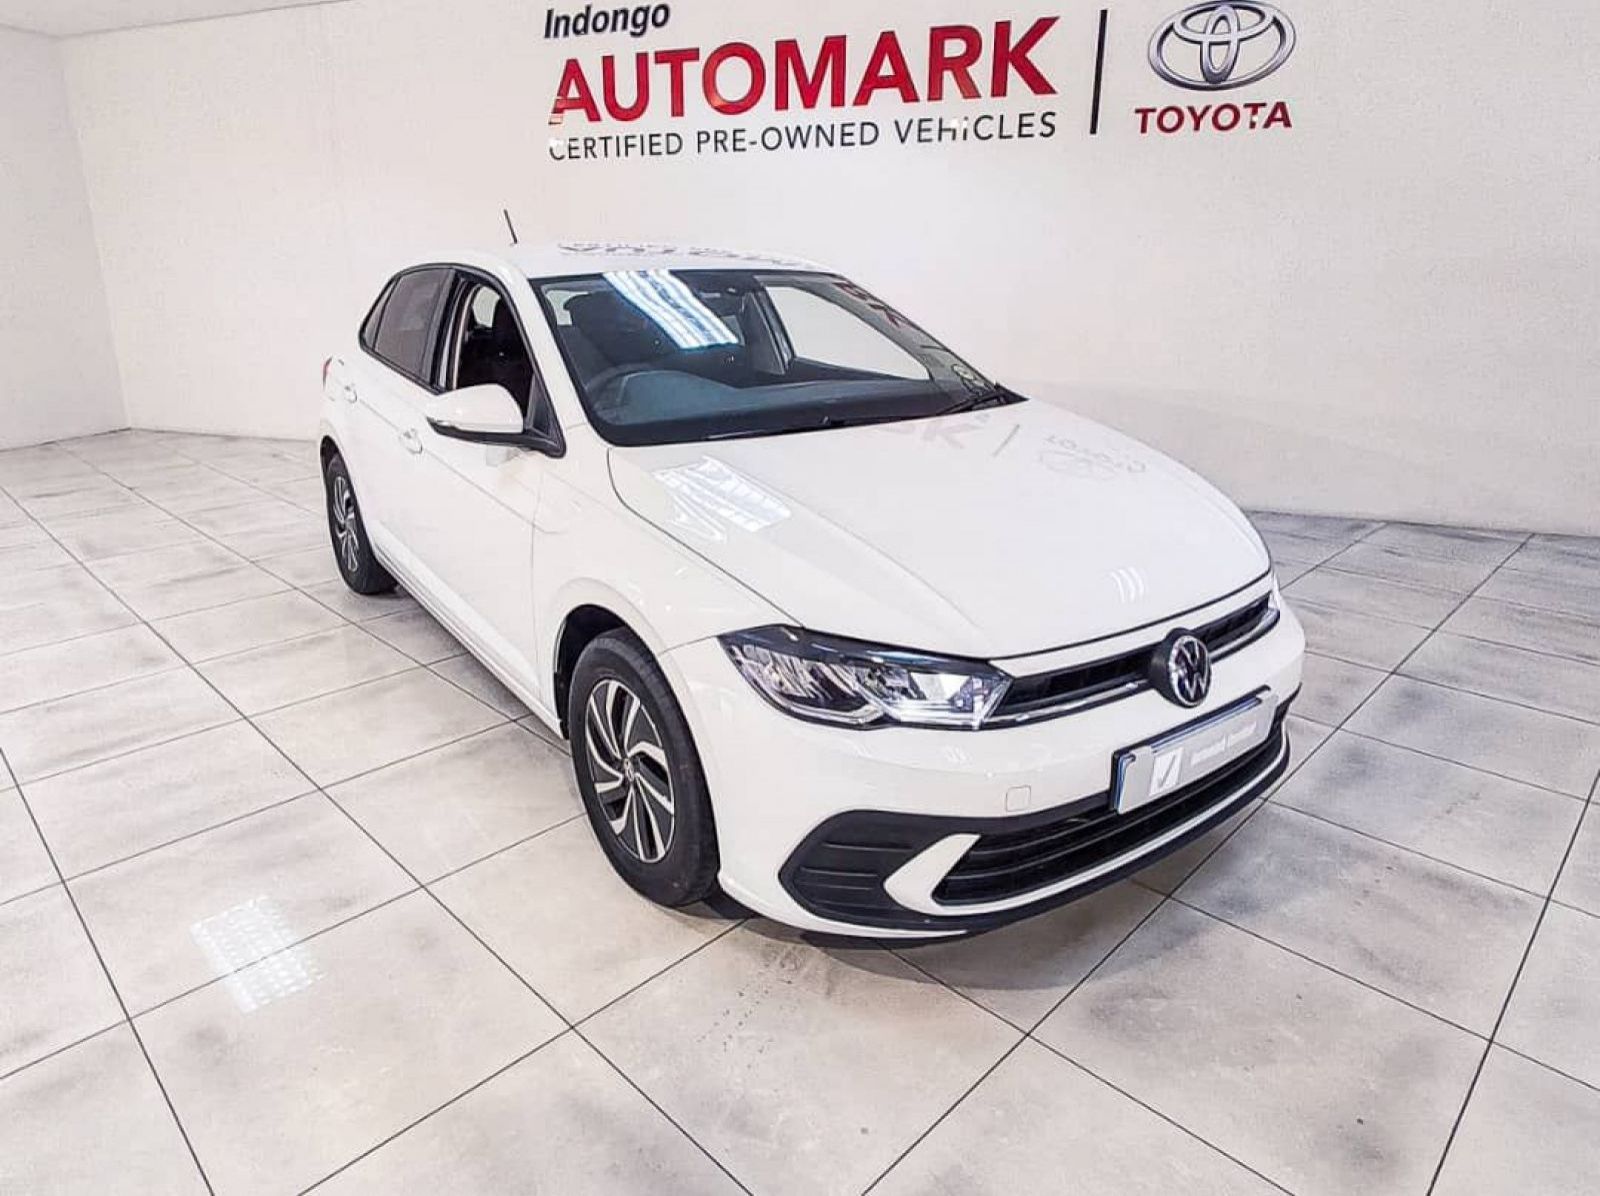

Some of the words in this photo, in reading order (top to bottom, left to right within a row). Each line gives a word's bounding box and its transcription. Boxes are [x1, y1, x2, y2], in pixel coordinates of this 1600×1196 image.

[544, 3, 671, 39] Indongo
[548, 16, 1061, 125] AUTOMARK
[549, 131, 683, 161] CERTIFIED
[696, 121, 879, 154] PRE-OWNED
[893, 111, 1057, 144] VEHICLES
[1134, 101, 1293, 134] TOYOTA
